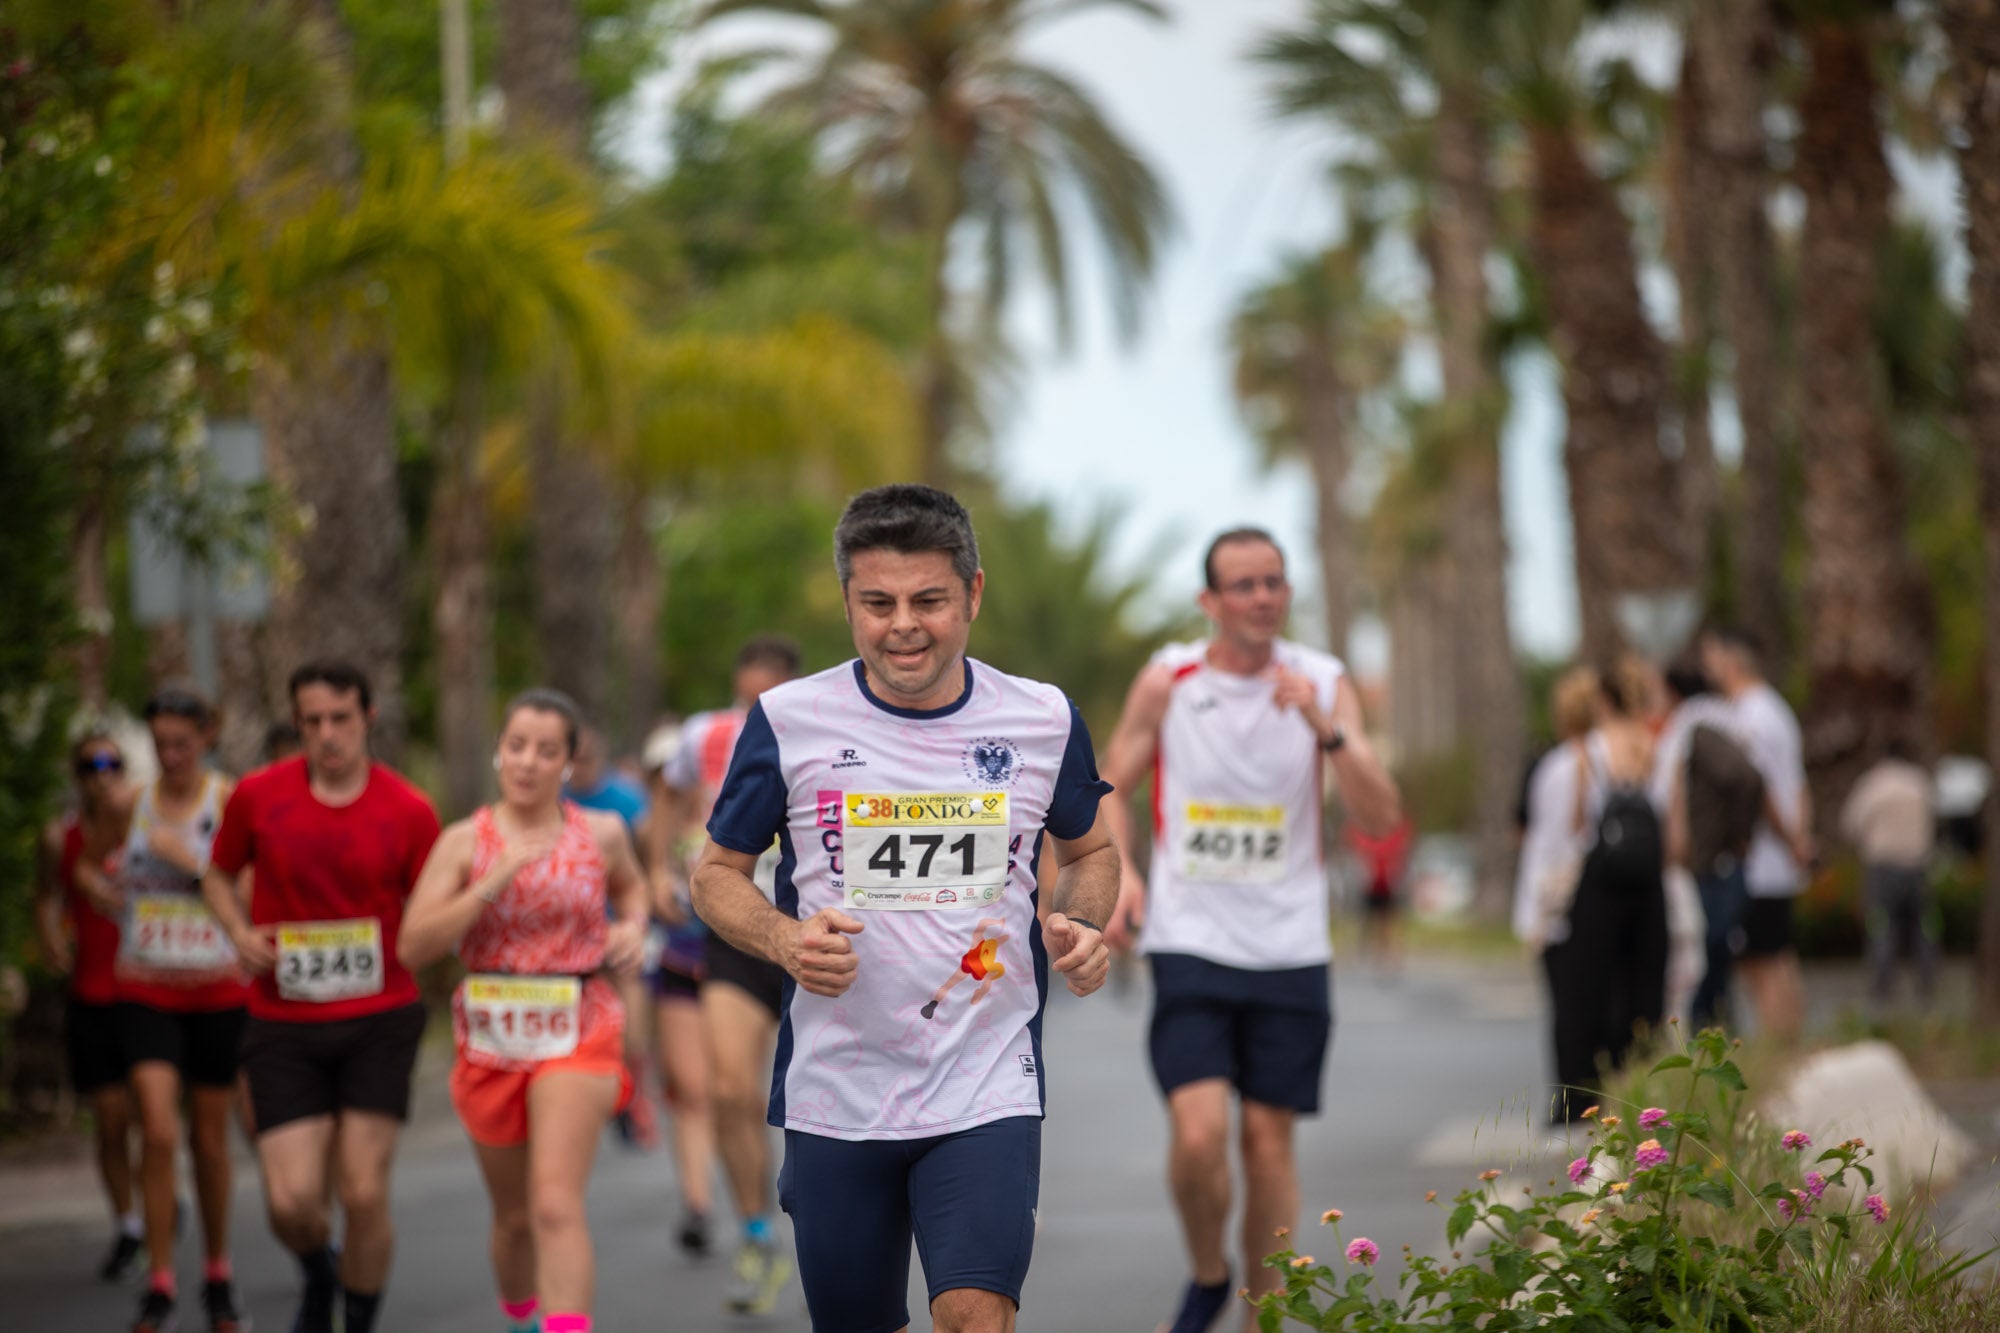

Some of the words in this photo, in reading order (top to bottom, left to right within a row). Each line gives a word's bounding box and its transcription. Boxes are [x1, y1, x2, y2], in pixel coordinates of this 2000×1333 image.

[868, 798, 893, 819] 38
[893, 803, 975, 820] FONDO
[929, 795, 967, 804] PREMIO
[868, 833, 976, 878] 471
[1186, 830, 1284, 861] 4012
[282, 951, 374, 984] 3249
